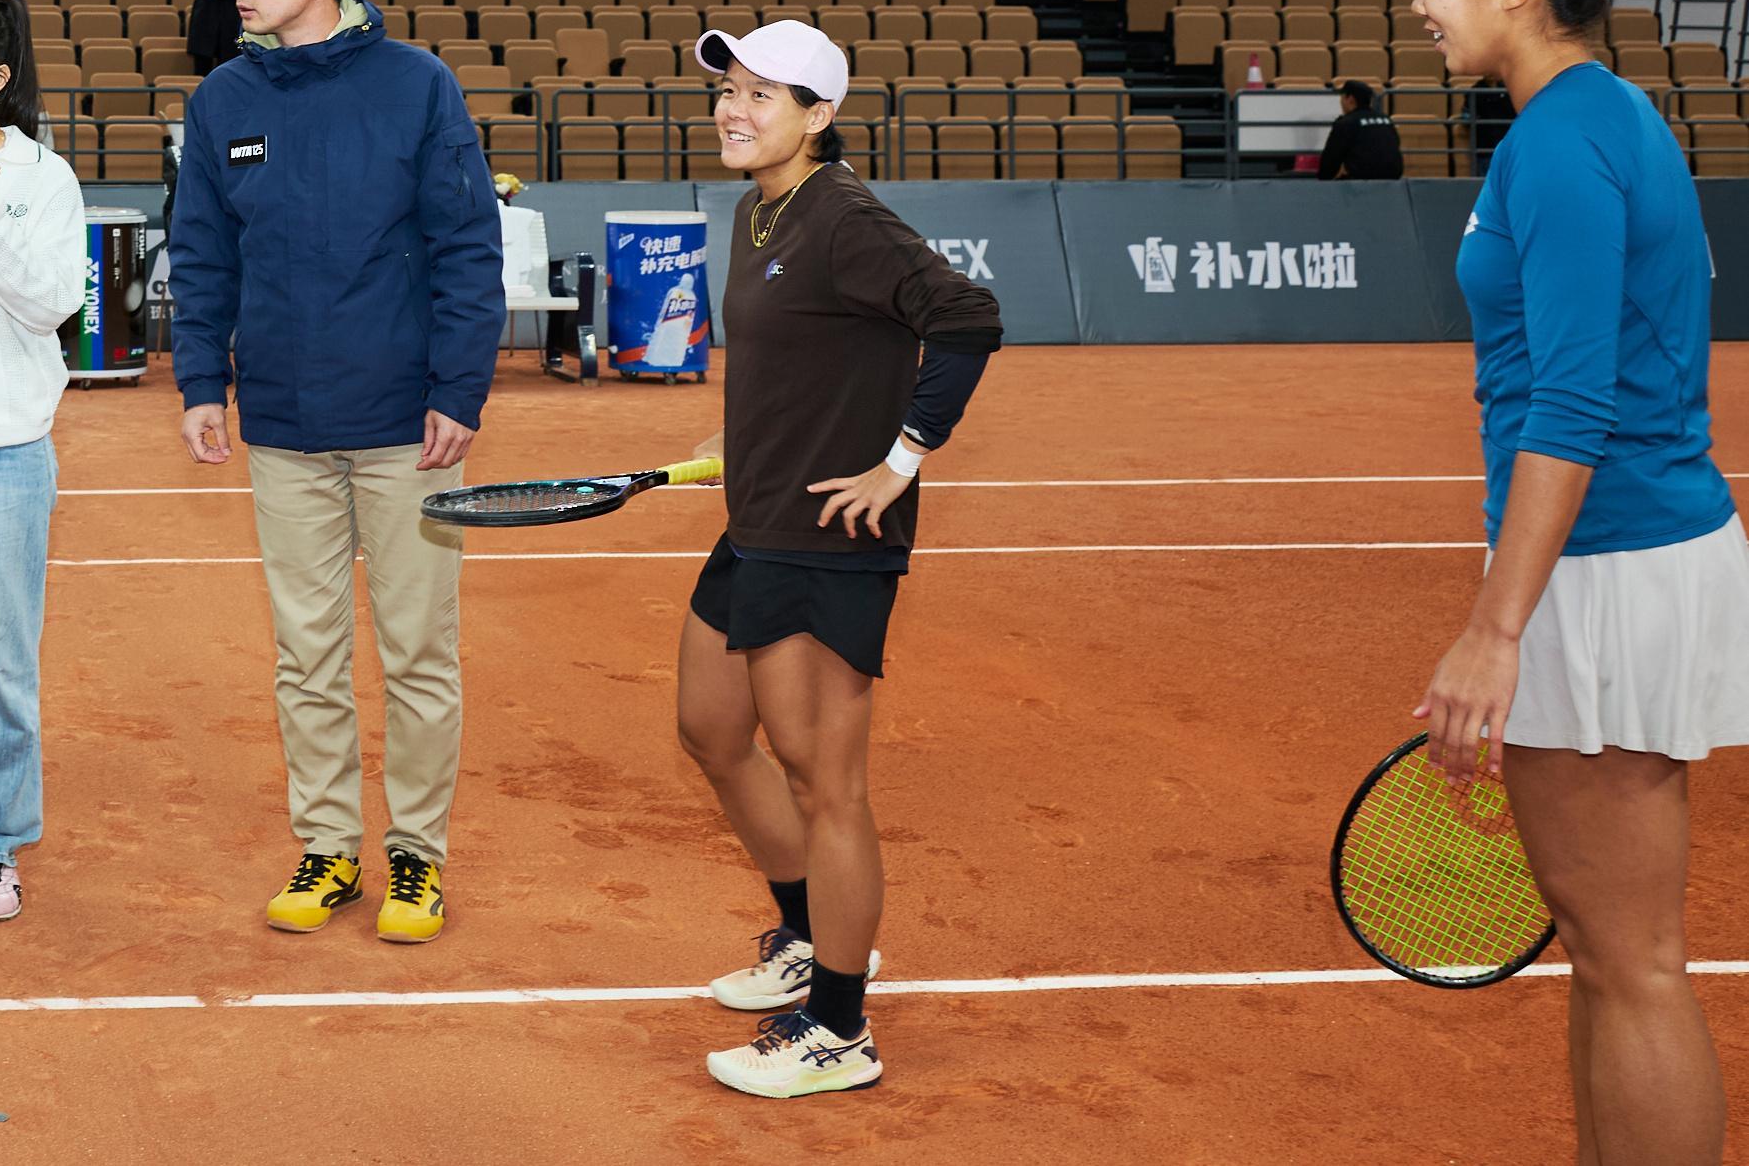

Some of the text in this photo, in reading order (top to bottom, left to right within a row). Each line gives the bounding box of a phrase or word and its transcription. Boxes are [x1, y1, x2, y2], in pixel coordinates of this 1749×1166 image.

[642, 235, 682, 255] 快速
[1190, 241, 1358, 289] 补水啦
[83, 285, 100, 335] YONEX
